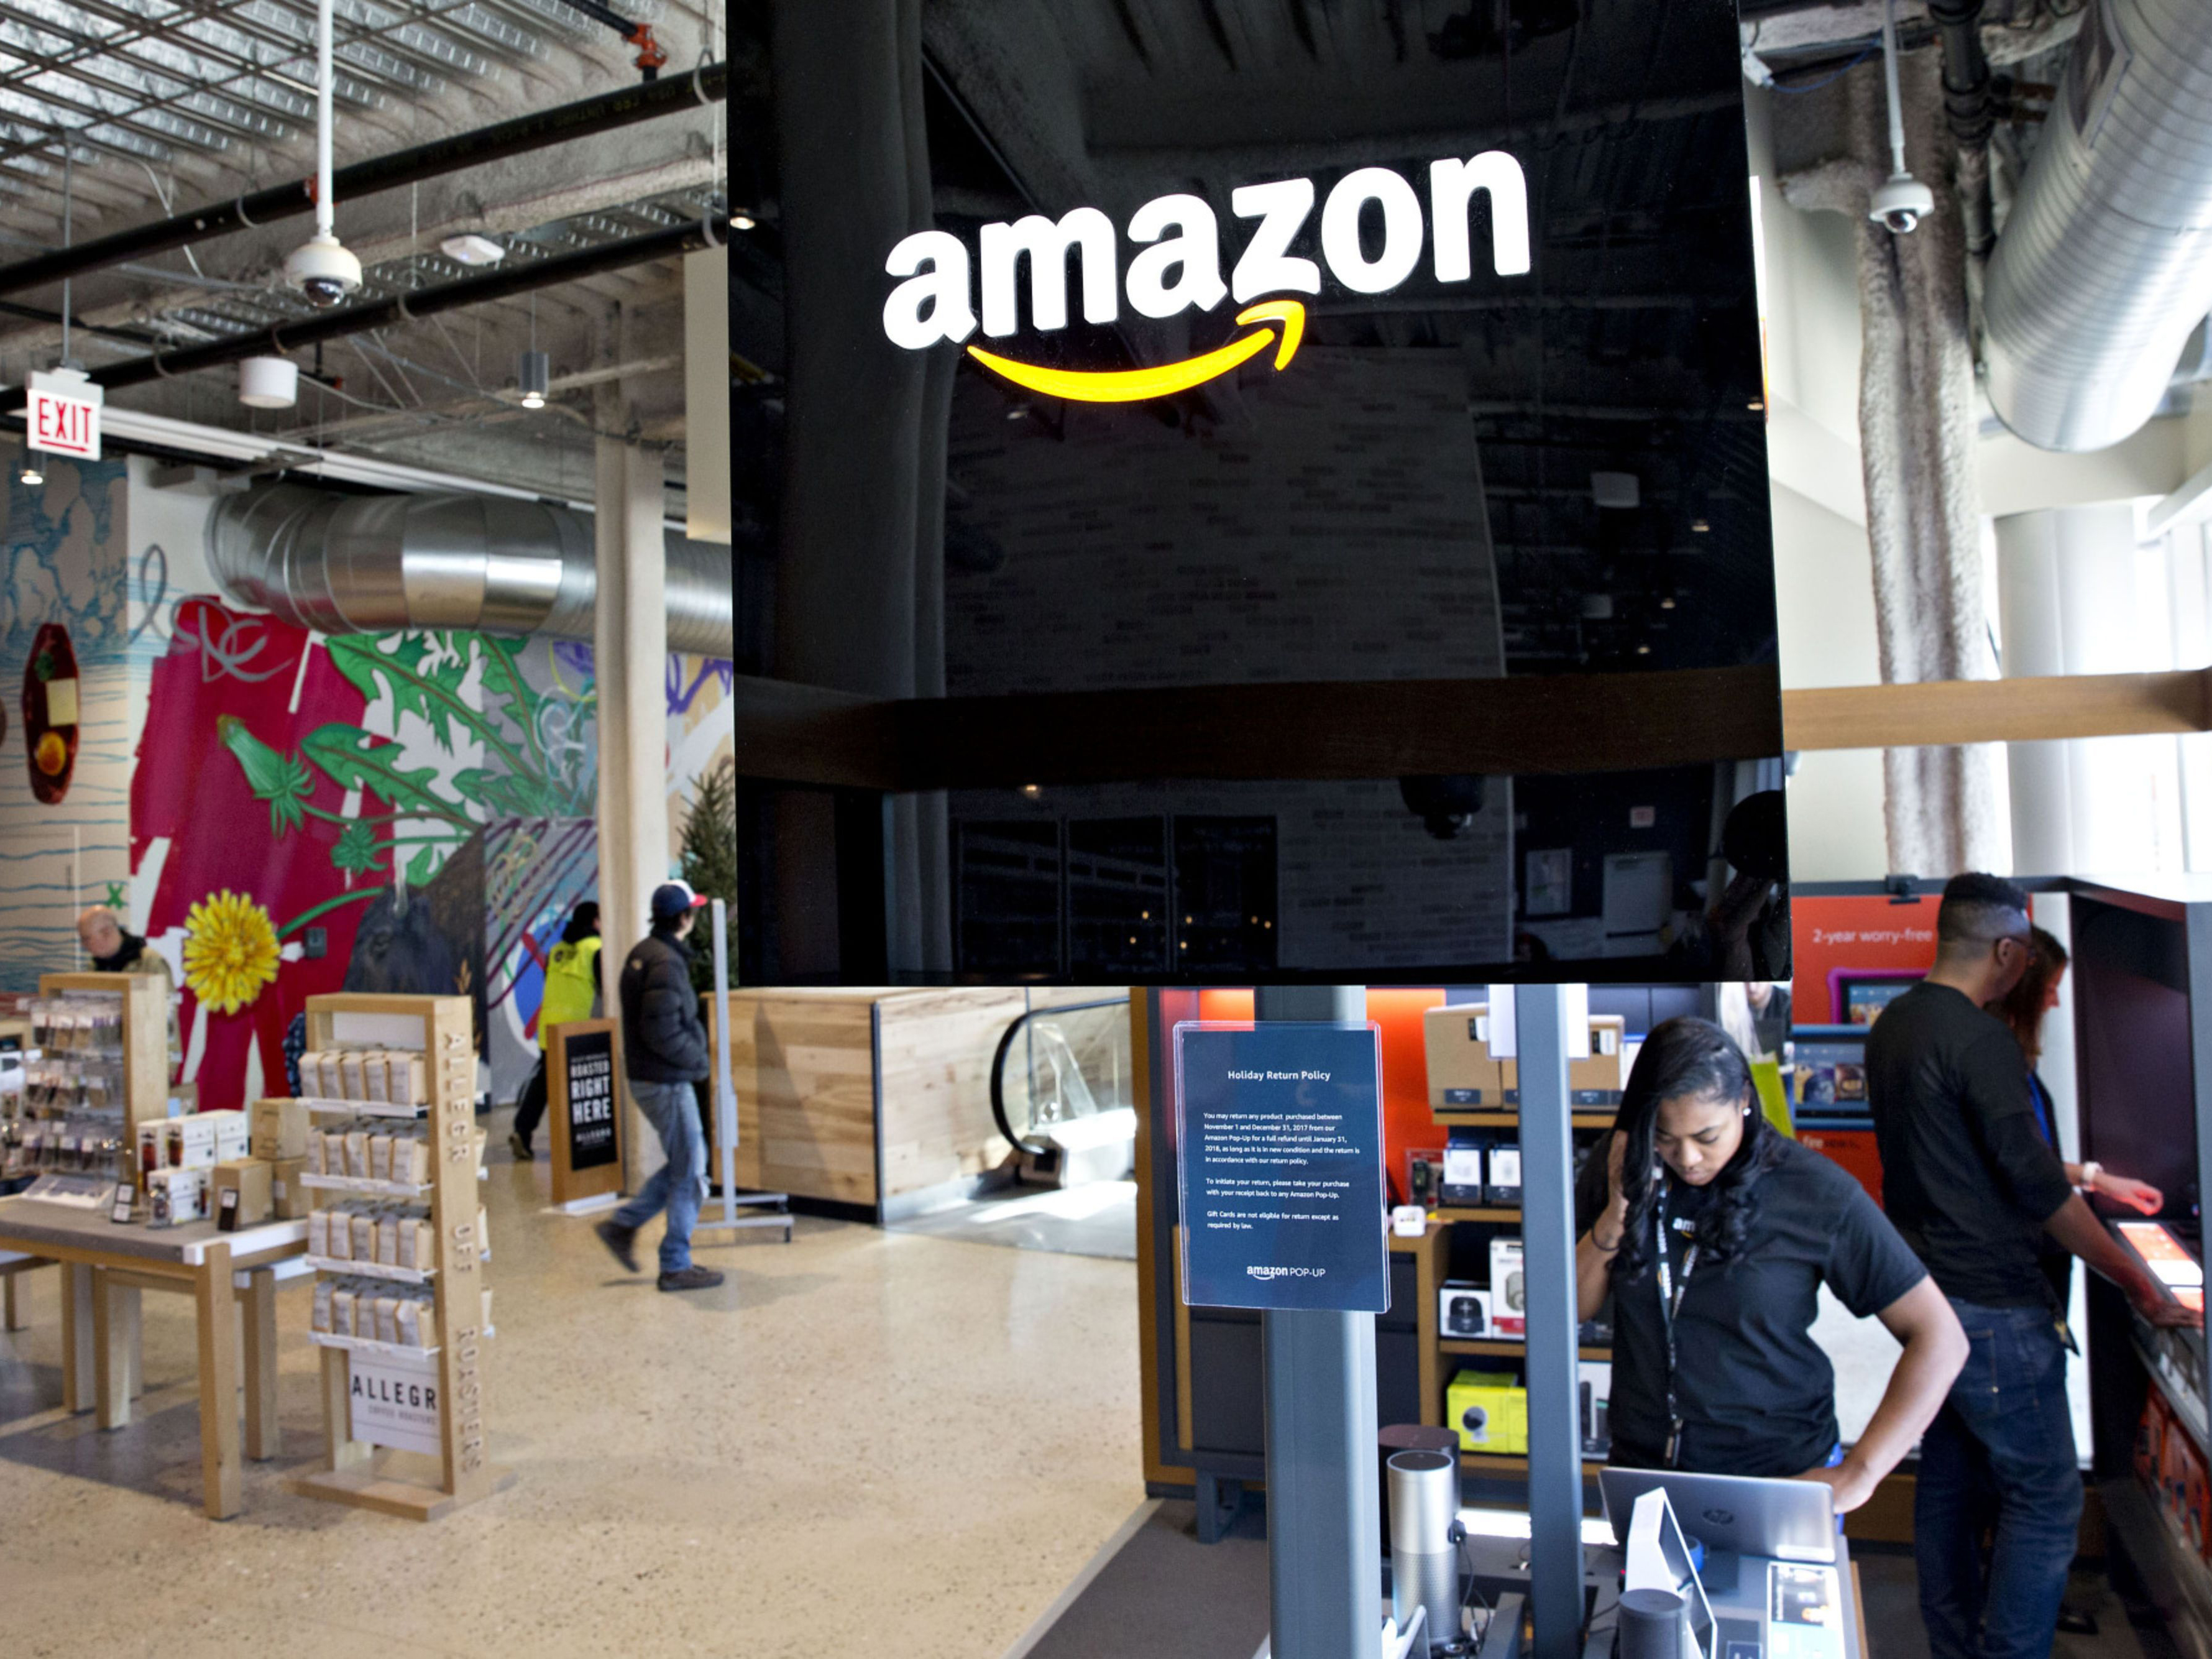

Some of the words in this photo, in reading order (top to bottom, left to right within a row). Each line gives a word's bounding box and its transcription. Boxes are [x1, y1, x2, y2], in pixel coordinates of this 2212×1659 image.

[883, 150, 1531, 349] amazon
[39, 398, 91, 443] EXIT
[1812, 928, 1856, 945] 2-year
[1859, 927, 1933, 945] worry-free
[571, 1060, 610, 1078] ROASTED
[1228, 1070, 1264, 1081] Holiday
[1267, 1071, 1298, 1080] Return
[1301, 1071, 1331, 1082] Policy
[571, 1075, 610, 1100] RIGHT
[572, 1097, 612, 1126] HERE
[1247, 1265, 1288, 1276] amazon
[1290, 1268, 1326, 1277] POP-UP
[352, 1374, 437, 1410] ALLEGR
